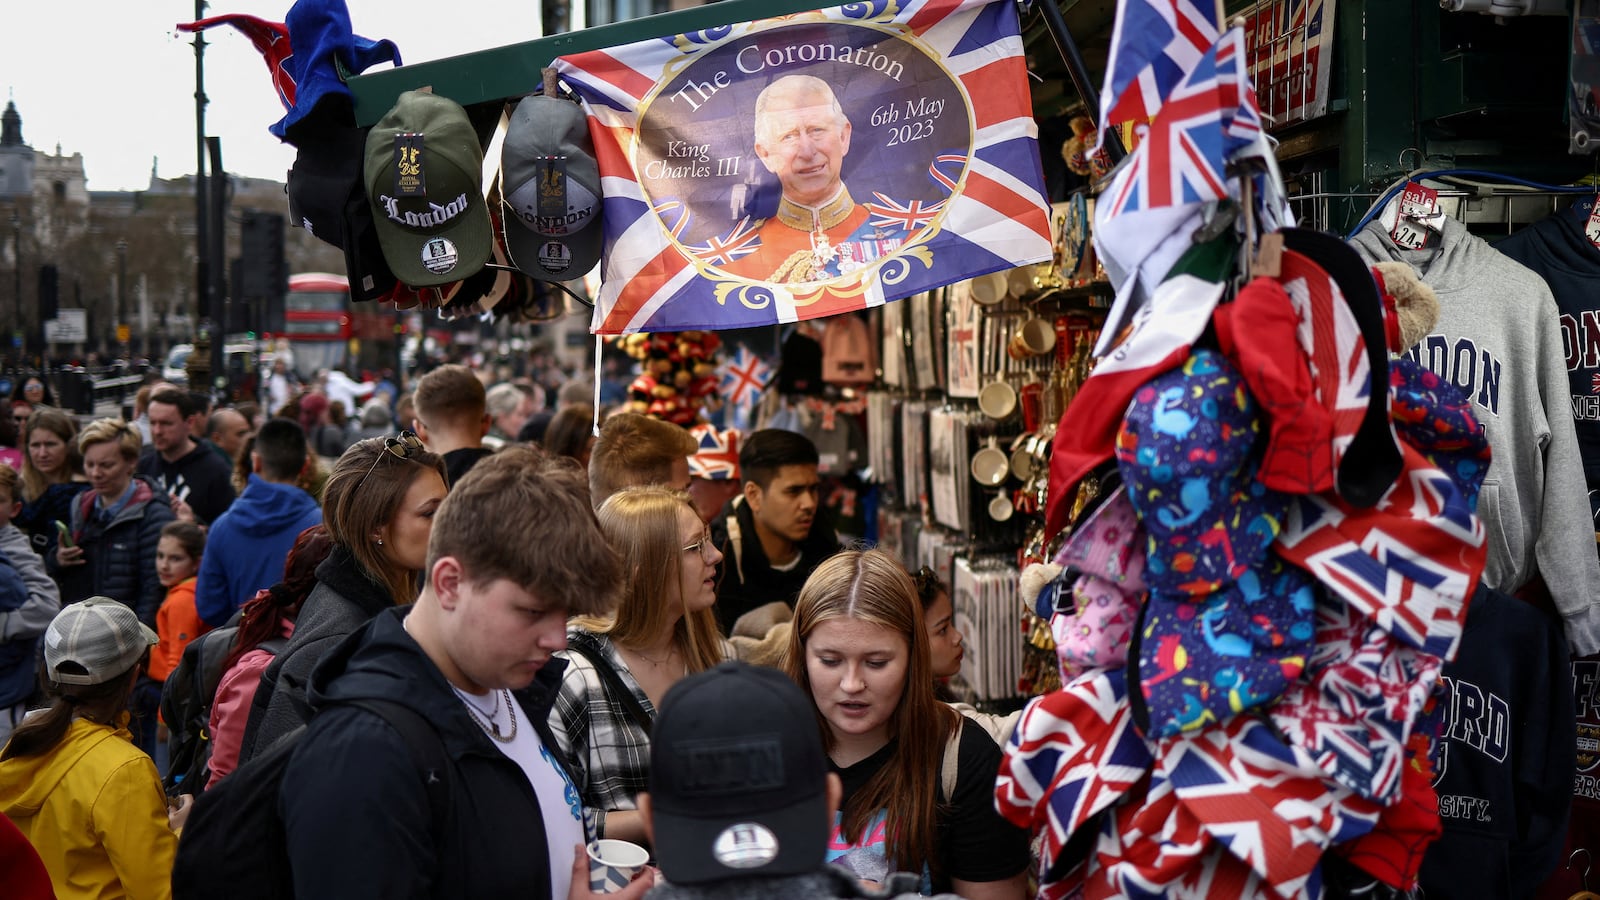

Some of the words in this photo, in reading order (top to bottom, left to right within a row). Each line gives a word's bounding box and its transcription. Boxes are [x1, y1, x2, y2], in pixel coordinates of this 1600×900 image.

[1246, 20, 1272, 54] THE
[670, 71, 732, 113] The
[735, 42, 905, 82] Coronation
[870, 105, 899, 128] 6th
[904, 97, 946, 119] May
[886, 118, 935, 147] 2023
[666, 141, 711, 162] King
[644, 159, 711, 181] Charles
[715, 157, 741, 178] III
[380, 192, 468, 228] London
[1404, 190, 1434, 206] sale
[513, 206, 593, 229] LONDON
